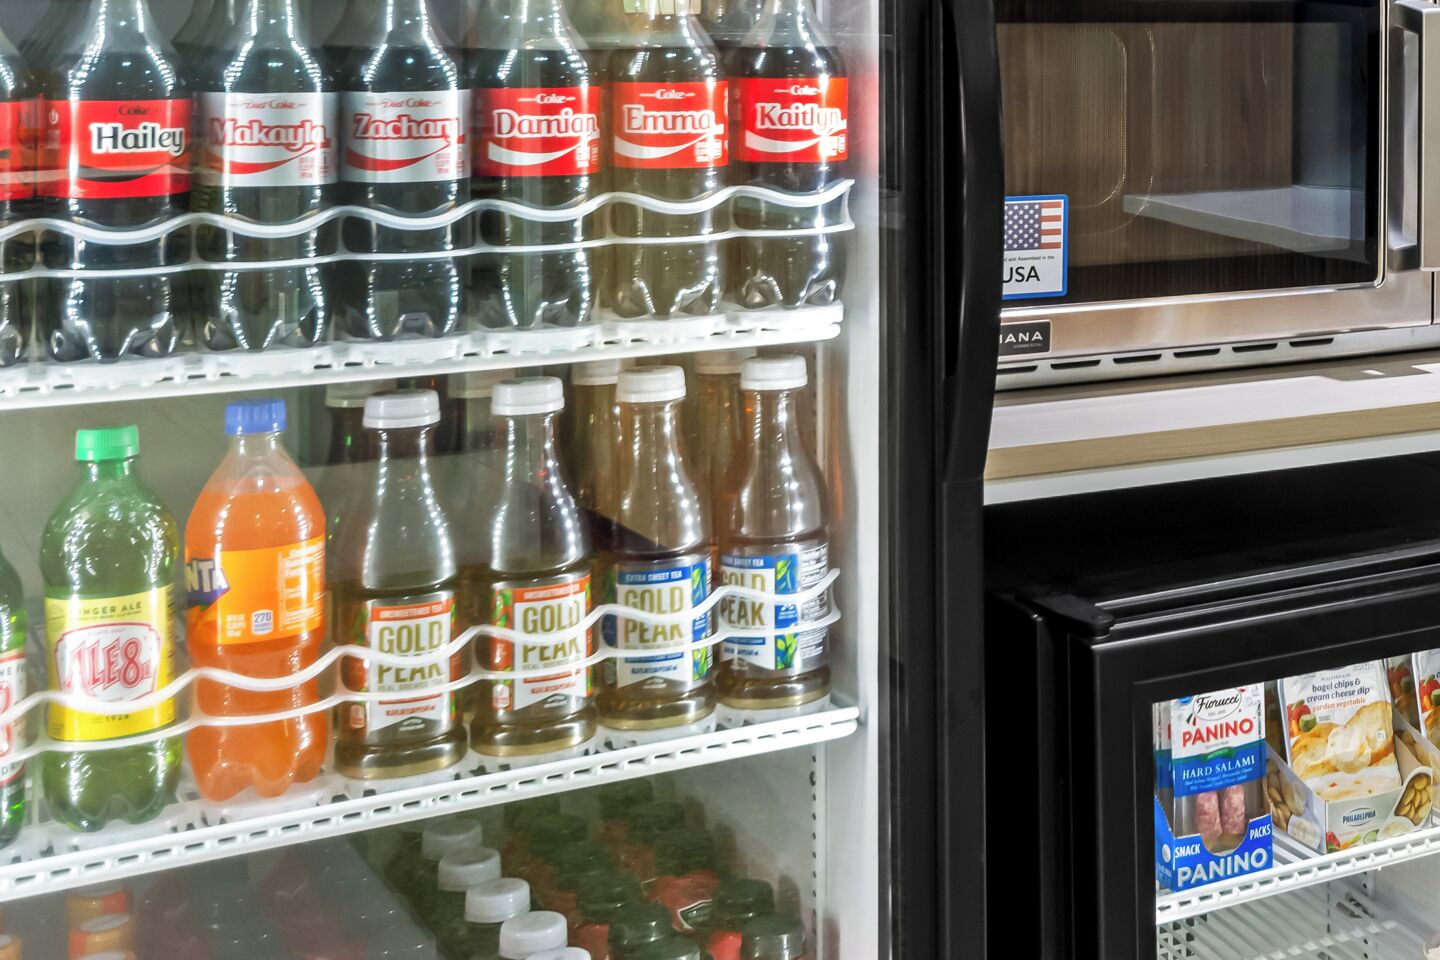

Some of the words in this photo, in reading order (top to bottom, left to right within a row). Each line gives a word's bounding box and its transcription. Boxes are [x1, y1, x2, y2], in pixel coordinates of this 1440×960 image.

[624, 106, 711, 132] Emma
[758, 104, 841, 135] Kaitlyn
[96, 126, 184, 151] Hailey
[721, 600, 765, 626] PEAK
[378, 621, 442, 654] GOLD
[1312, 684, 1333, 693] bagel
[1334, 680, 1353, 688] chips
[1182, 718, 1254, 747] PANINO
[1183, 768, 1212, 780] HARD
[1216, 755, 1255, 773] SALAMI
[1250, 824, 1271, 840] PACKS
[1175, 844, 1200, 858] SNACK
[1178, 848, 1268, 887] PANINO
